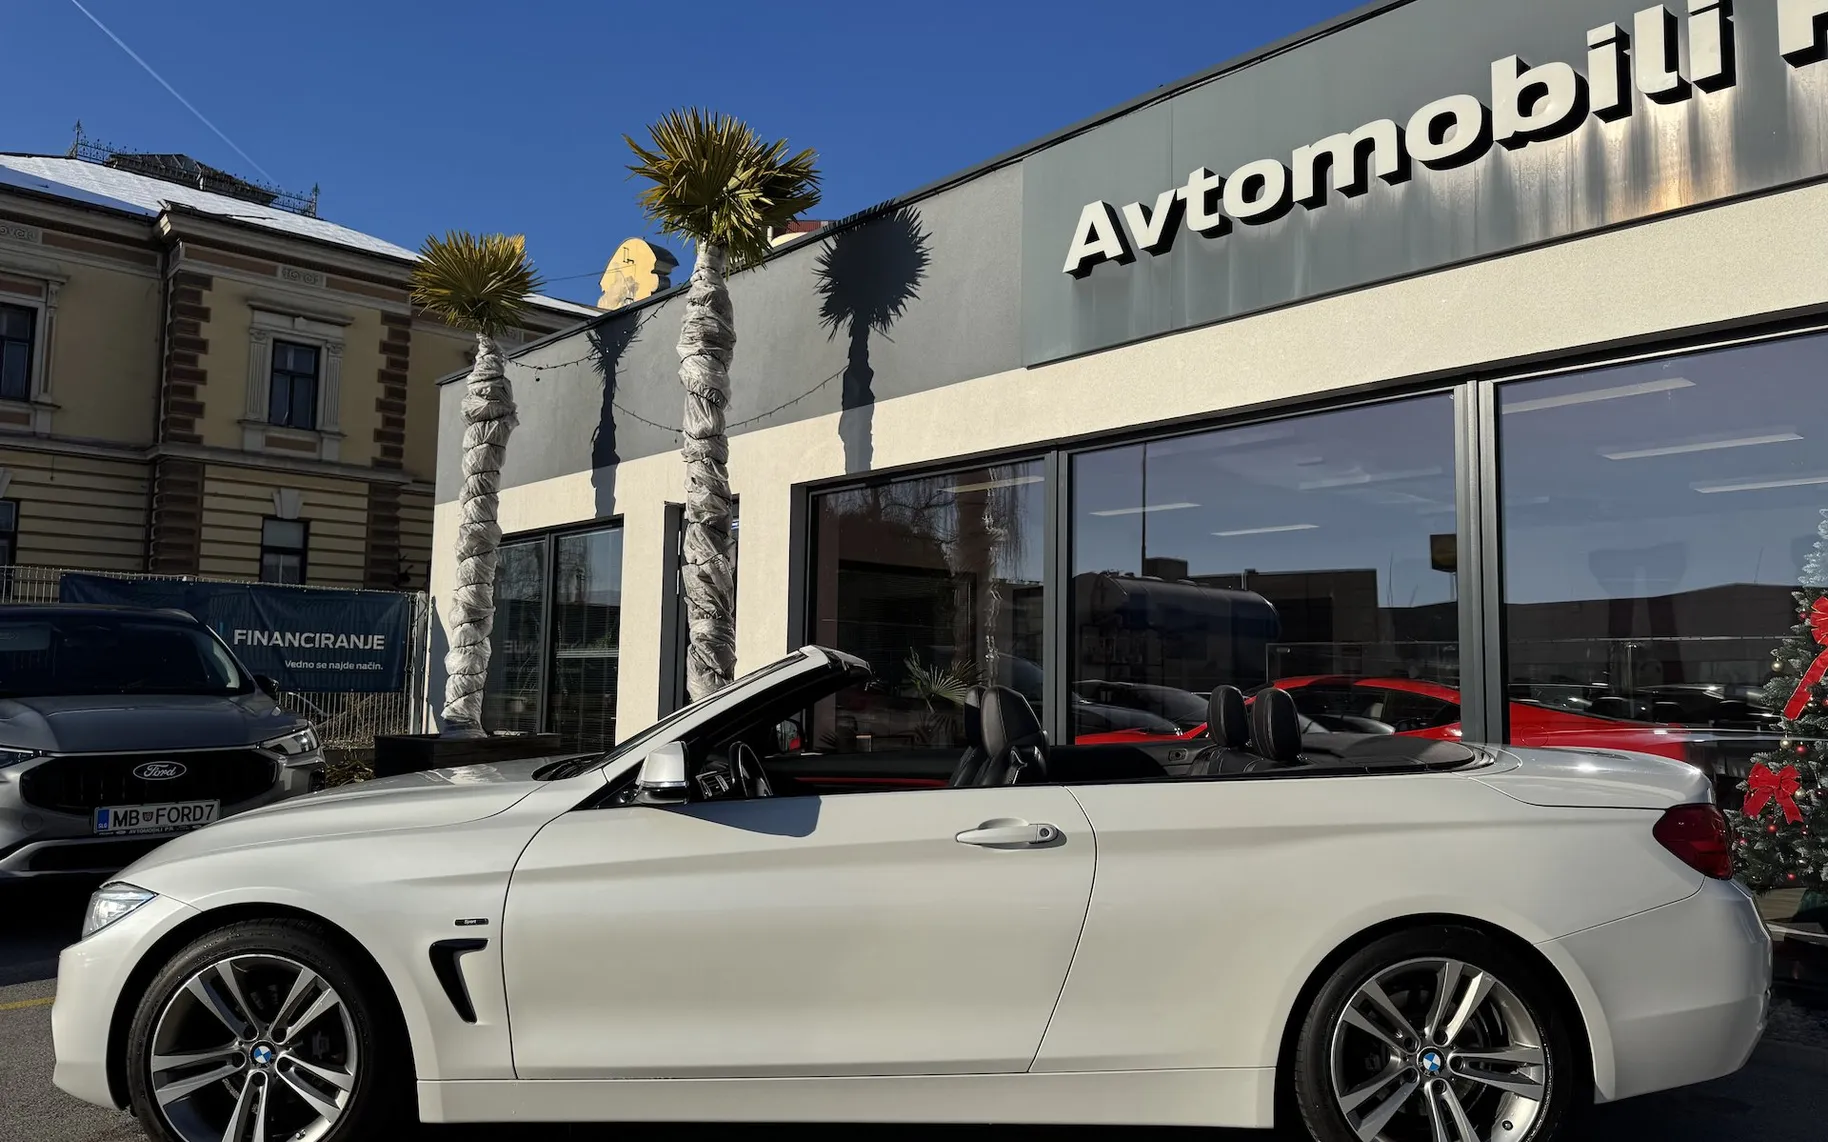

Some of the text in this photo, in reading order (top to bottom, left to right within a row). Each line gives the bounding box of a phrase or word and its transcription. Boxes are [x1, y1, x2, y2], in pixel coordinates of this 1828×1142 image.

[1062, 0, 1735, 279] Avtomobili
[233, 629, 386, 650] FINANCIRANJE
[285, 660, 315, 669] Vedno
[328, 662, 355, 671] najde
[356, 662, 384, 670] način.
[143, 764, 177, 777] Ford
[112, 804, 215, 828] MB FORD7
